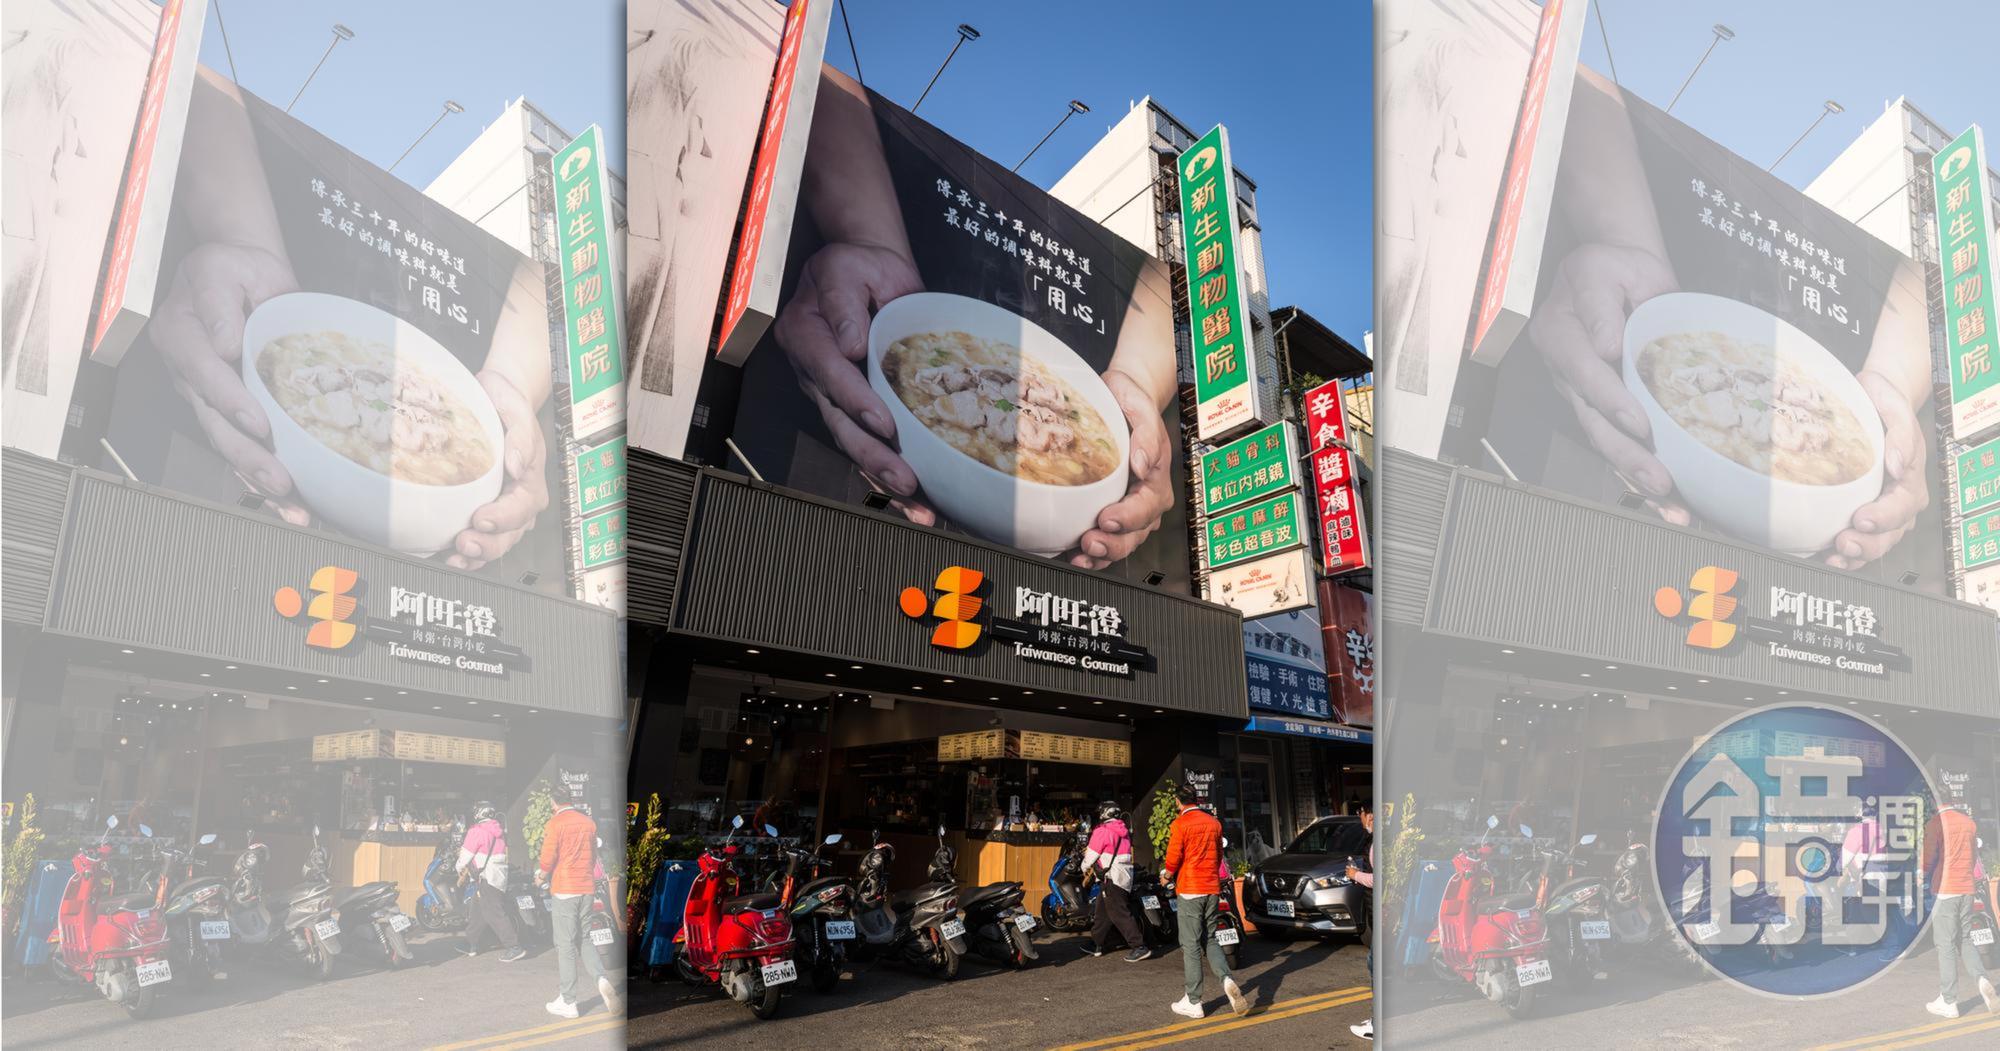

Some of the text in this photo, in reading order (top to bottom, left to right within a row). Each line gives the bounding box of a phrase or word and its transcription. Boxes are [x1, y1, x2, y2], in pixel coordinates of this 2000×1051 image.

[311, 178, 467, 276] 傳承三十年的好味道
[319, 206, 461, 295] 最好的調味料就是
[936, 178, 1092, 276] 傳承三十年的好味道
[944, 206, 1086, 295] 最好的調味料就是
[1691, 178, 1847, 276] 傳承三十年的好味道
[1699, 206, 1841, 295] 最好的調味料就是
[565, 175, 613, 384] 新生動物醫院
[1033, 275, 1105, 335] 「用心」
[1190, 175, 1238, 384] 新生動物醫院
[1945, 175, 1993, 384] 新生動物醫院
[1210, 461, 1284, 505] 數位內視鏡
[1213, 501, 1289, 539] 氣體麻醉
[1214, 525, 1292, 560] 彩色超音波
[390, 586, 497, 637] 阿旺澄
[1015, 586, 1122, 637] 阿旺澄
[1770, 586, 1877, 637] 阿旺澄
[389, 641, 504, 675] Taiwanese Gourmet
[1014, 641, 1129, 675] Taiwanese Gourmet
[1769, 641, 1884, 675] Taiwanese Gourmet
[764, 966, 796, 983] 285-NWA
